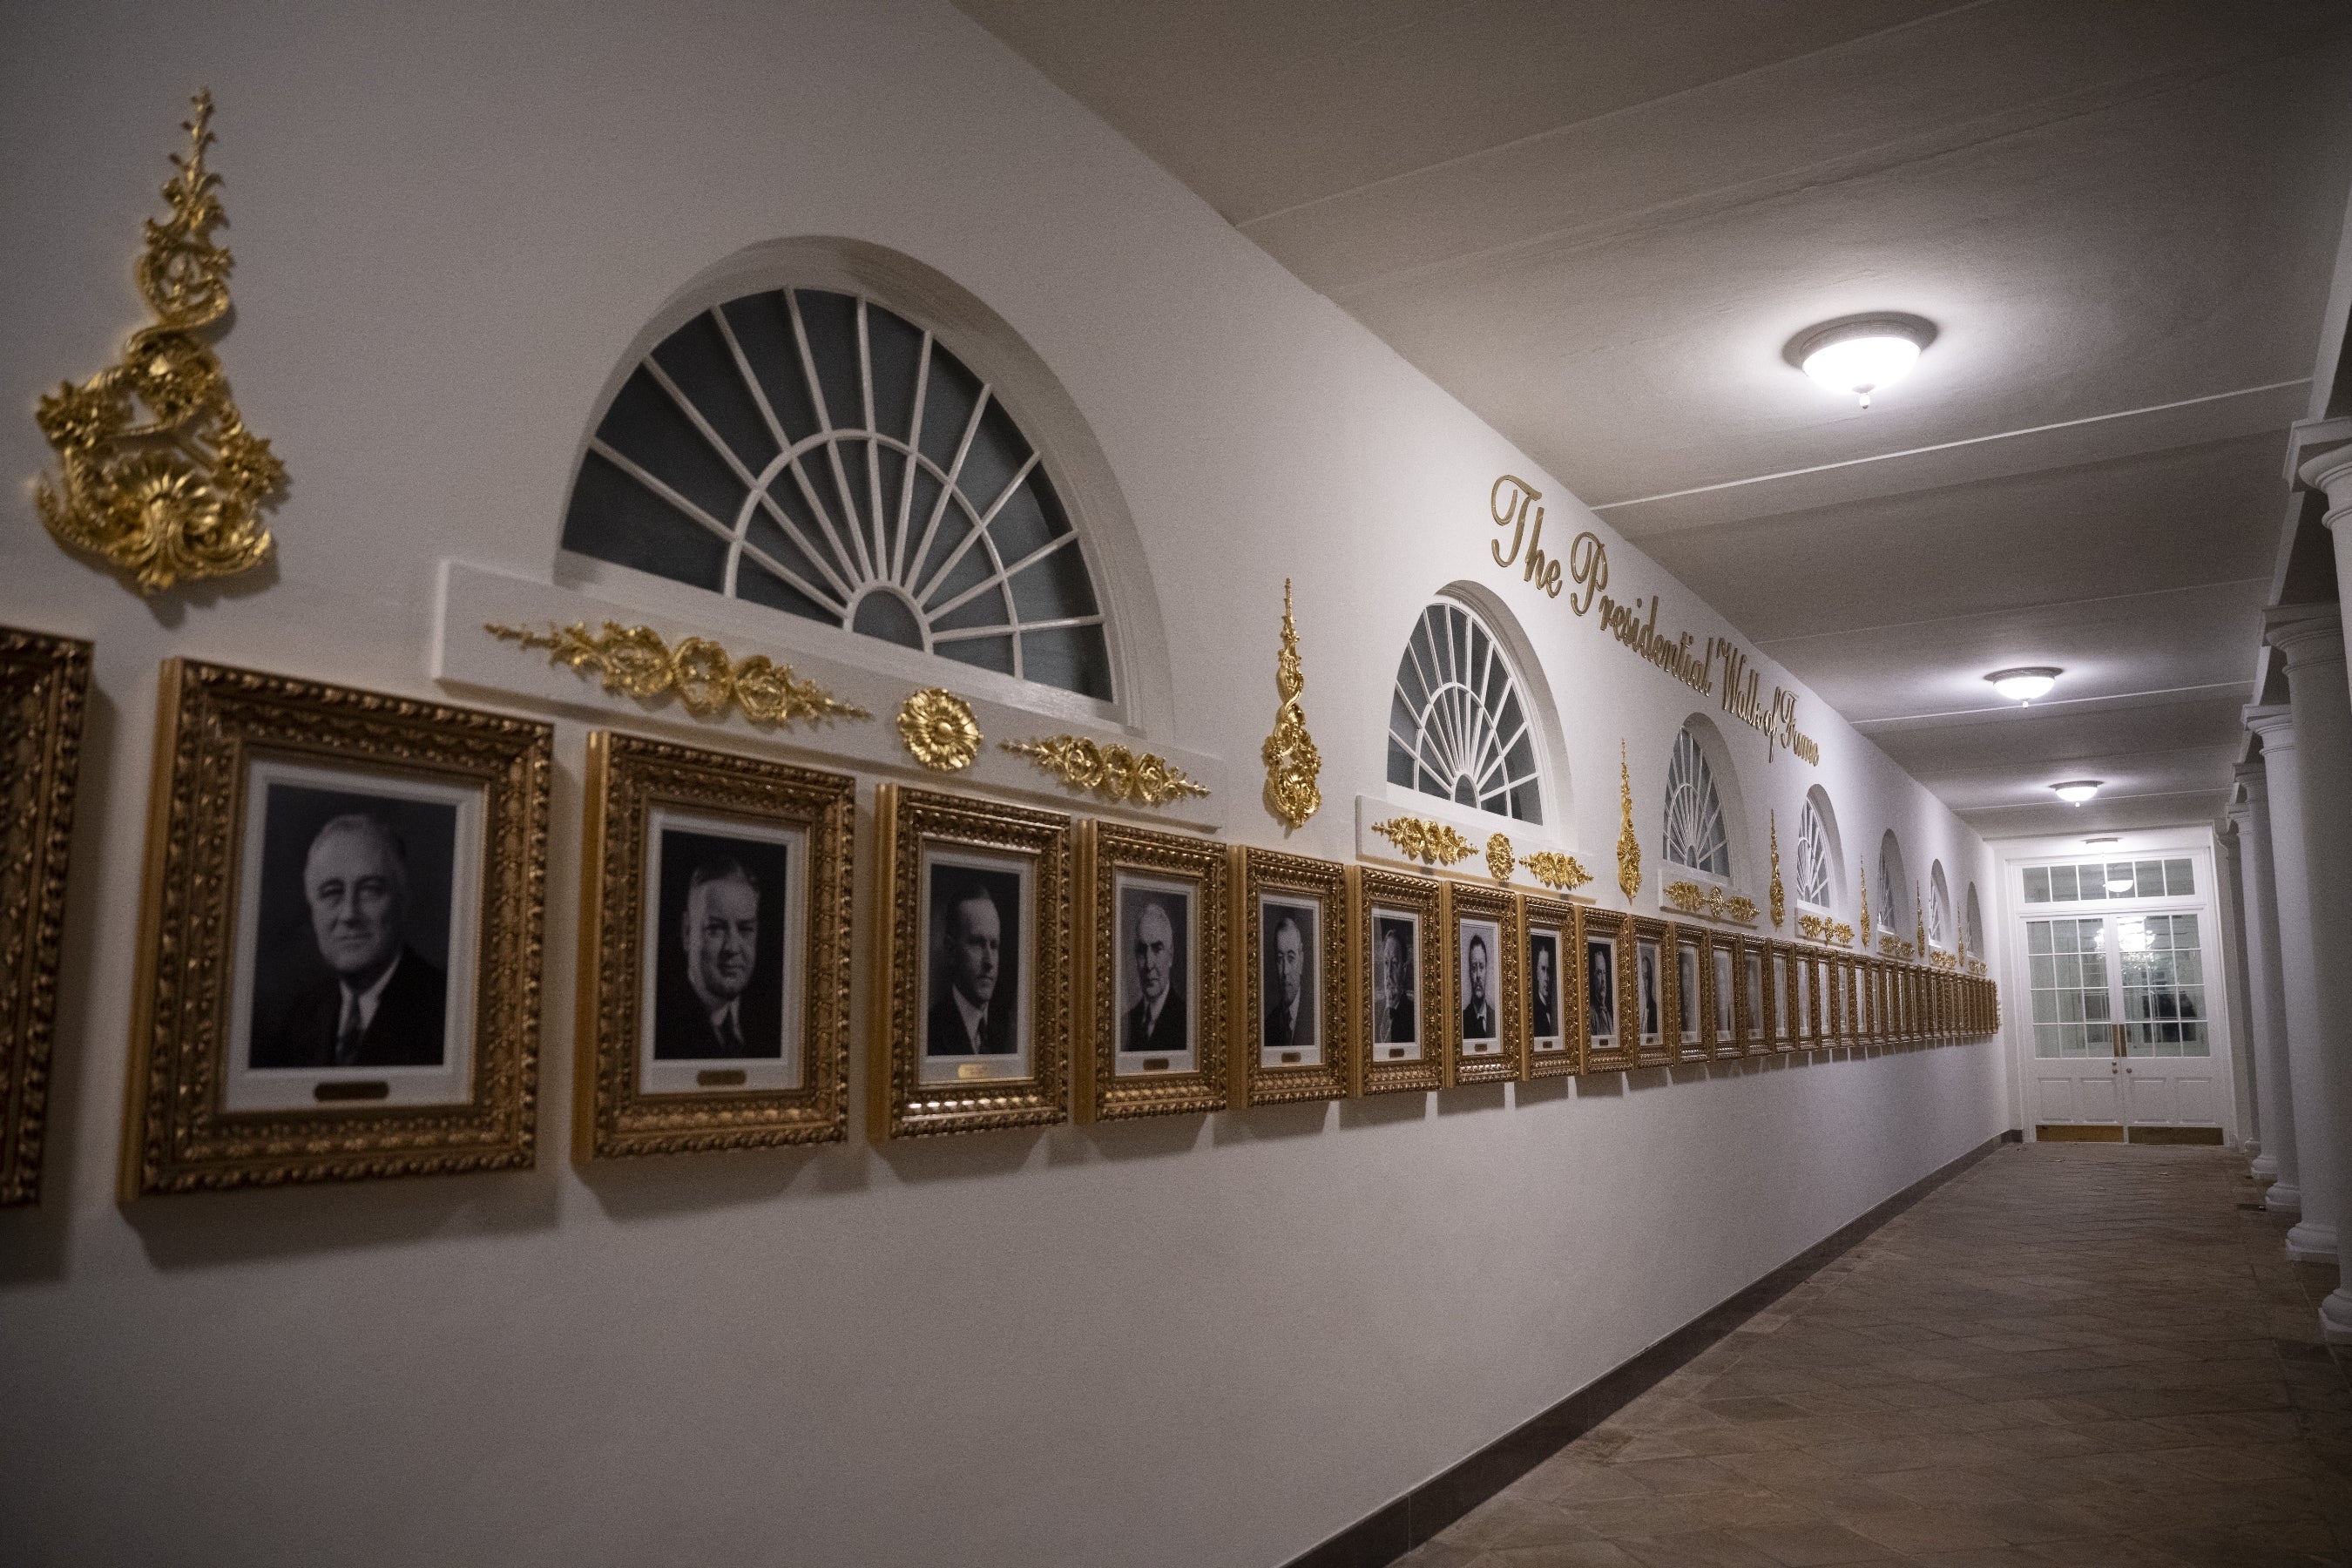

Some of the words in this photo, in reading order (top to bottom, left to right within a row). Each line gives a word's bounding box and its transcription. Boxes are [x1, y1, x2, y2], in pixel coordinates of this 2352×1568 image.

[1491, 475, 1562, 598] The
[1571, 532, 1713, 697] Presidential
[1717, 638, 1762, 730] Walk
[1763, 686, 1781, 763] of
[1781, 691, 1819, 767] Fame
